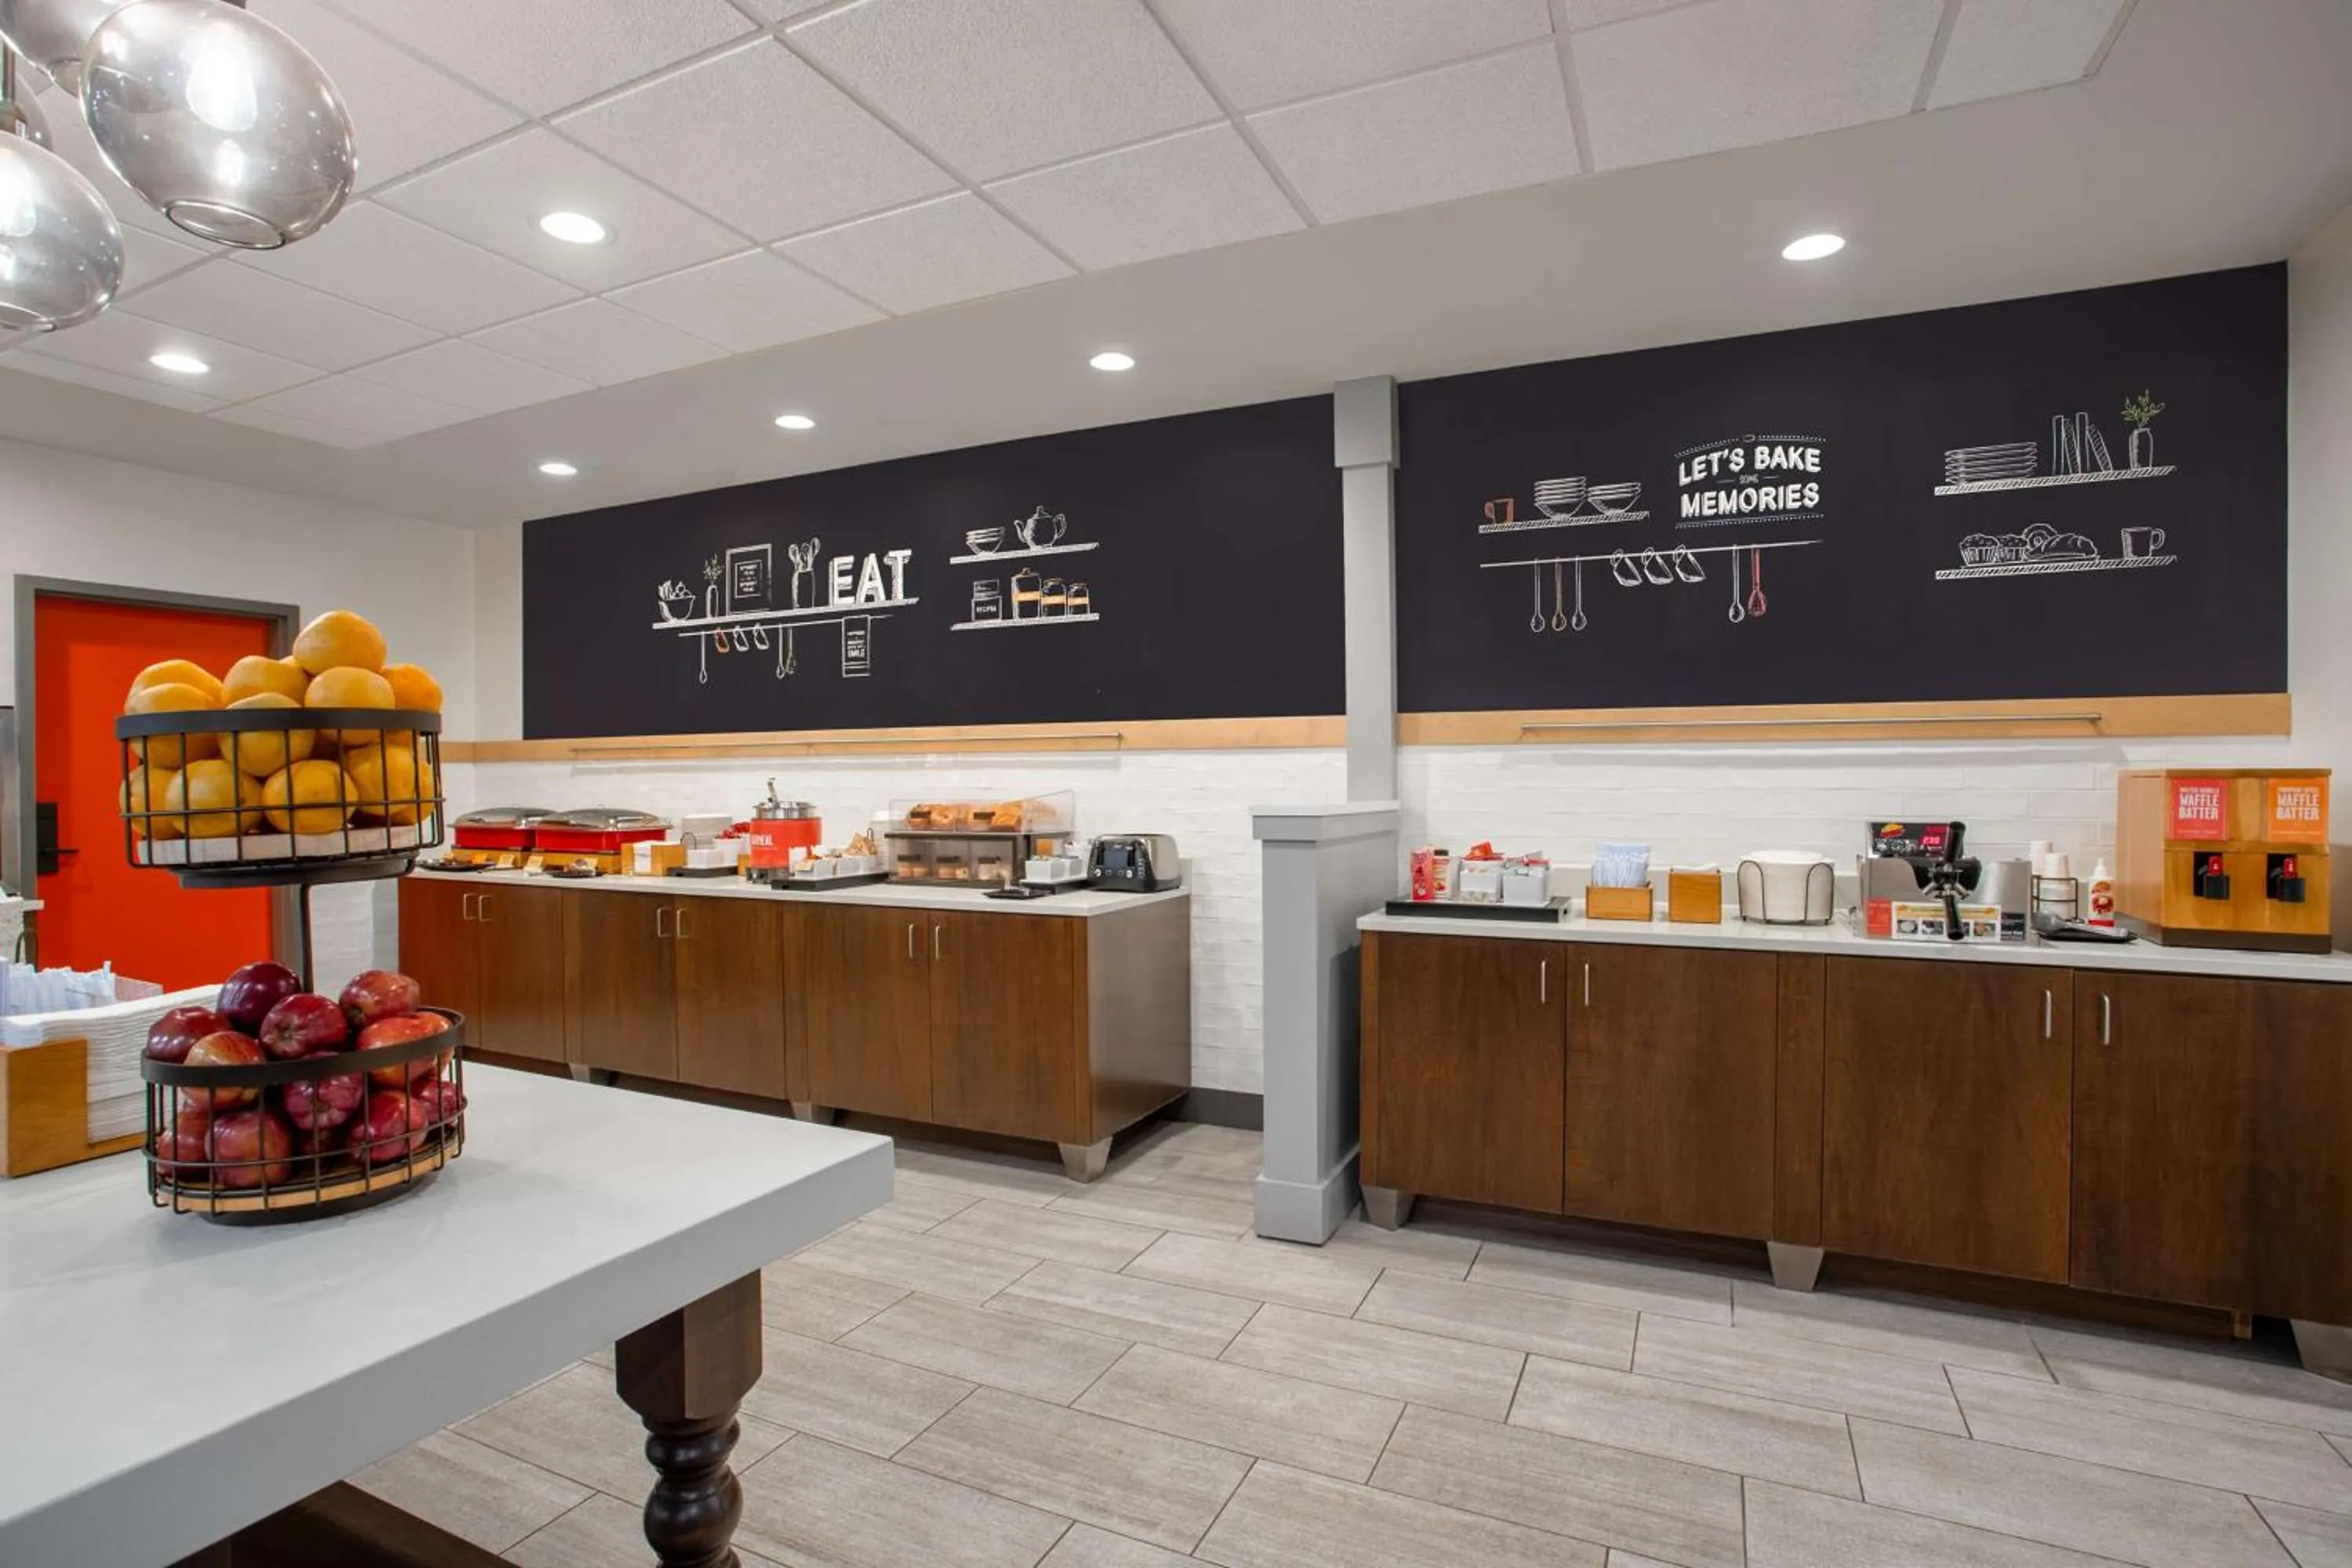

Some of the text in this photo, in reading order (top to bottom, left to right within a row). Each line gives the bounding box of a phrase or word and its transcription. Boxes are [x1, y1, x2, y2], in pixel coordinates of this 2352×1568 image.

[1679, 445, 1822, 487] LET'S BAKE
[1680, 482, 1820, 518] MEMORIES
[829, 549, 912, 608] EAT
[2180, 793, 2220, 807] WAFFLE
[2278, 793, 2321, 807] WAFFLE
[2179, 807, 2219, 820] BATTER
[2277, 807, 2320, 820] BATTER
